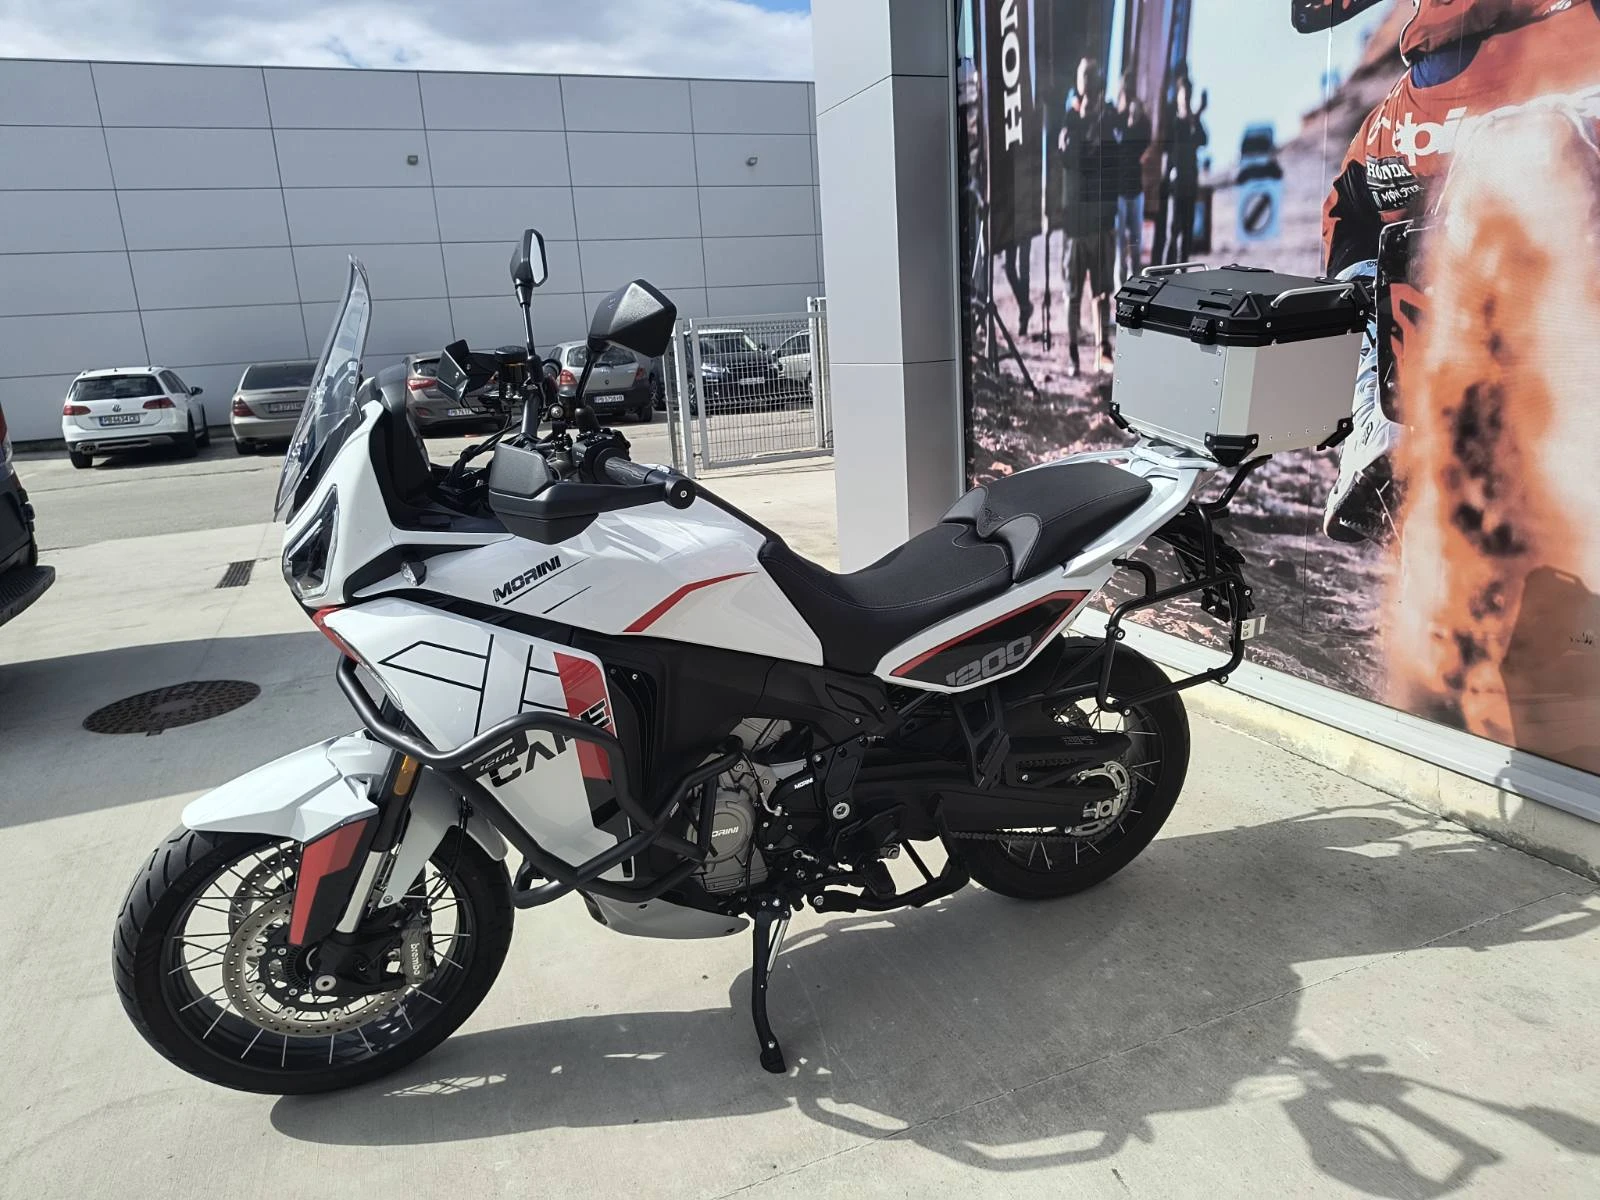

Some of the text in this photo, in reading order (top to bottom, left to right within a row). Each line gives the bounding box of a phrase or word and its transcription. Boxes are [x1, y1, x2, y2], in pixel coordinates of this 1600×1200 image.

[1366, 160, 1413, 181] HONDA
[492, 555, 562, 603] MORINI
[946, 635, 1032, 687] 1200
[711, 826, 739, 838] ORINI
[410, 942, 422, 976] brembo
